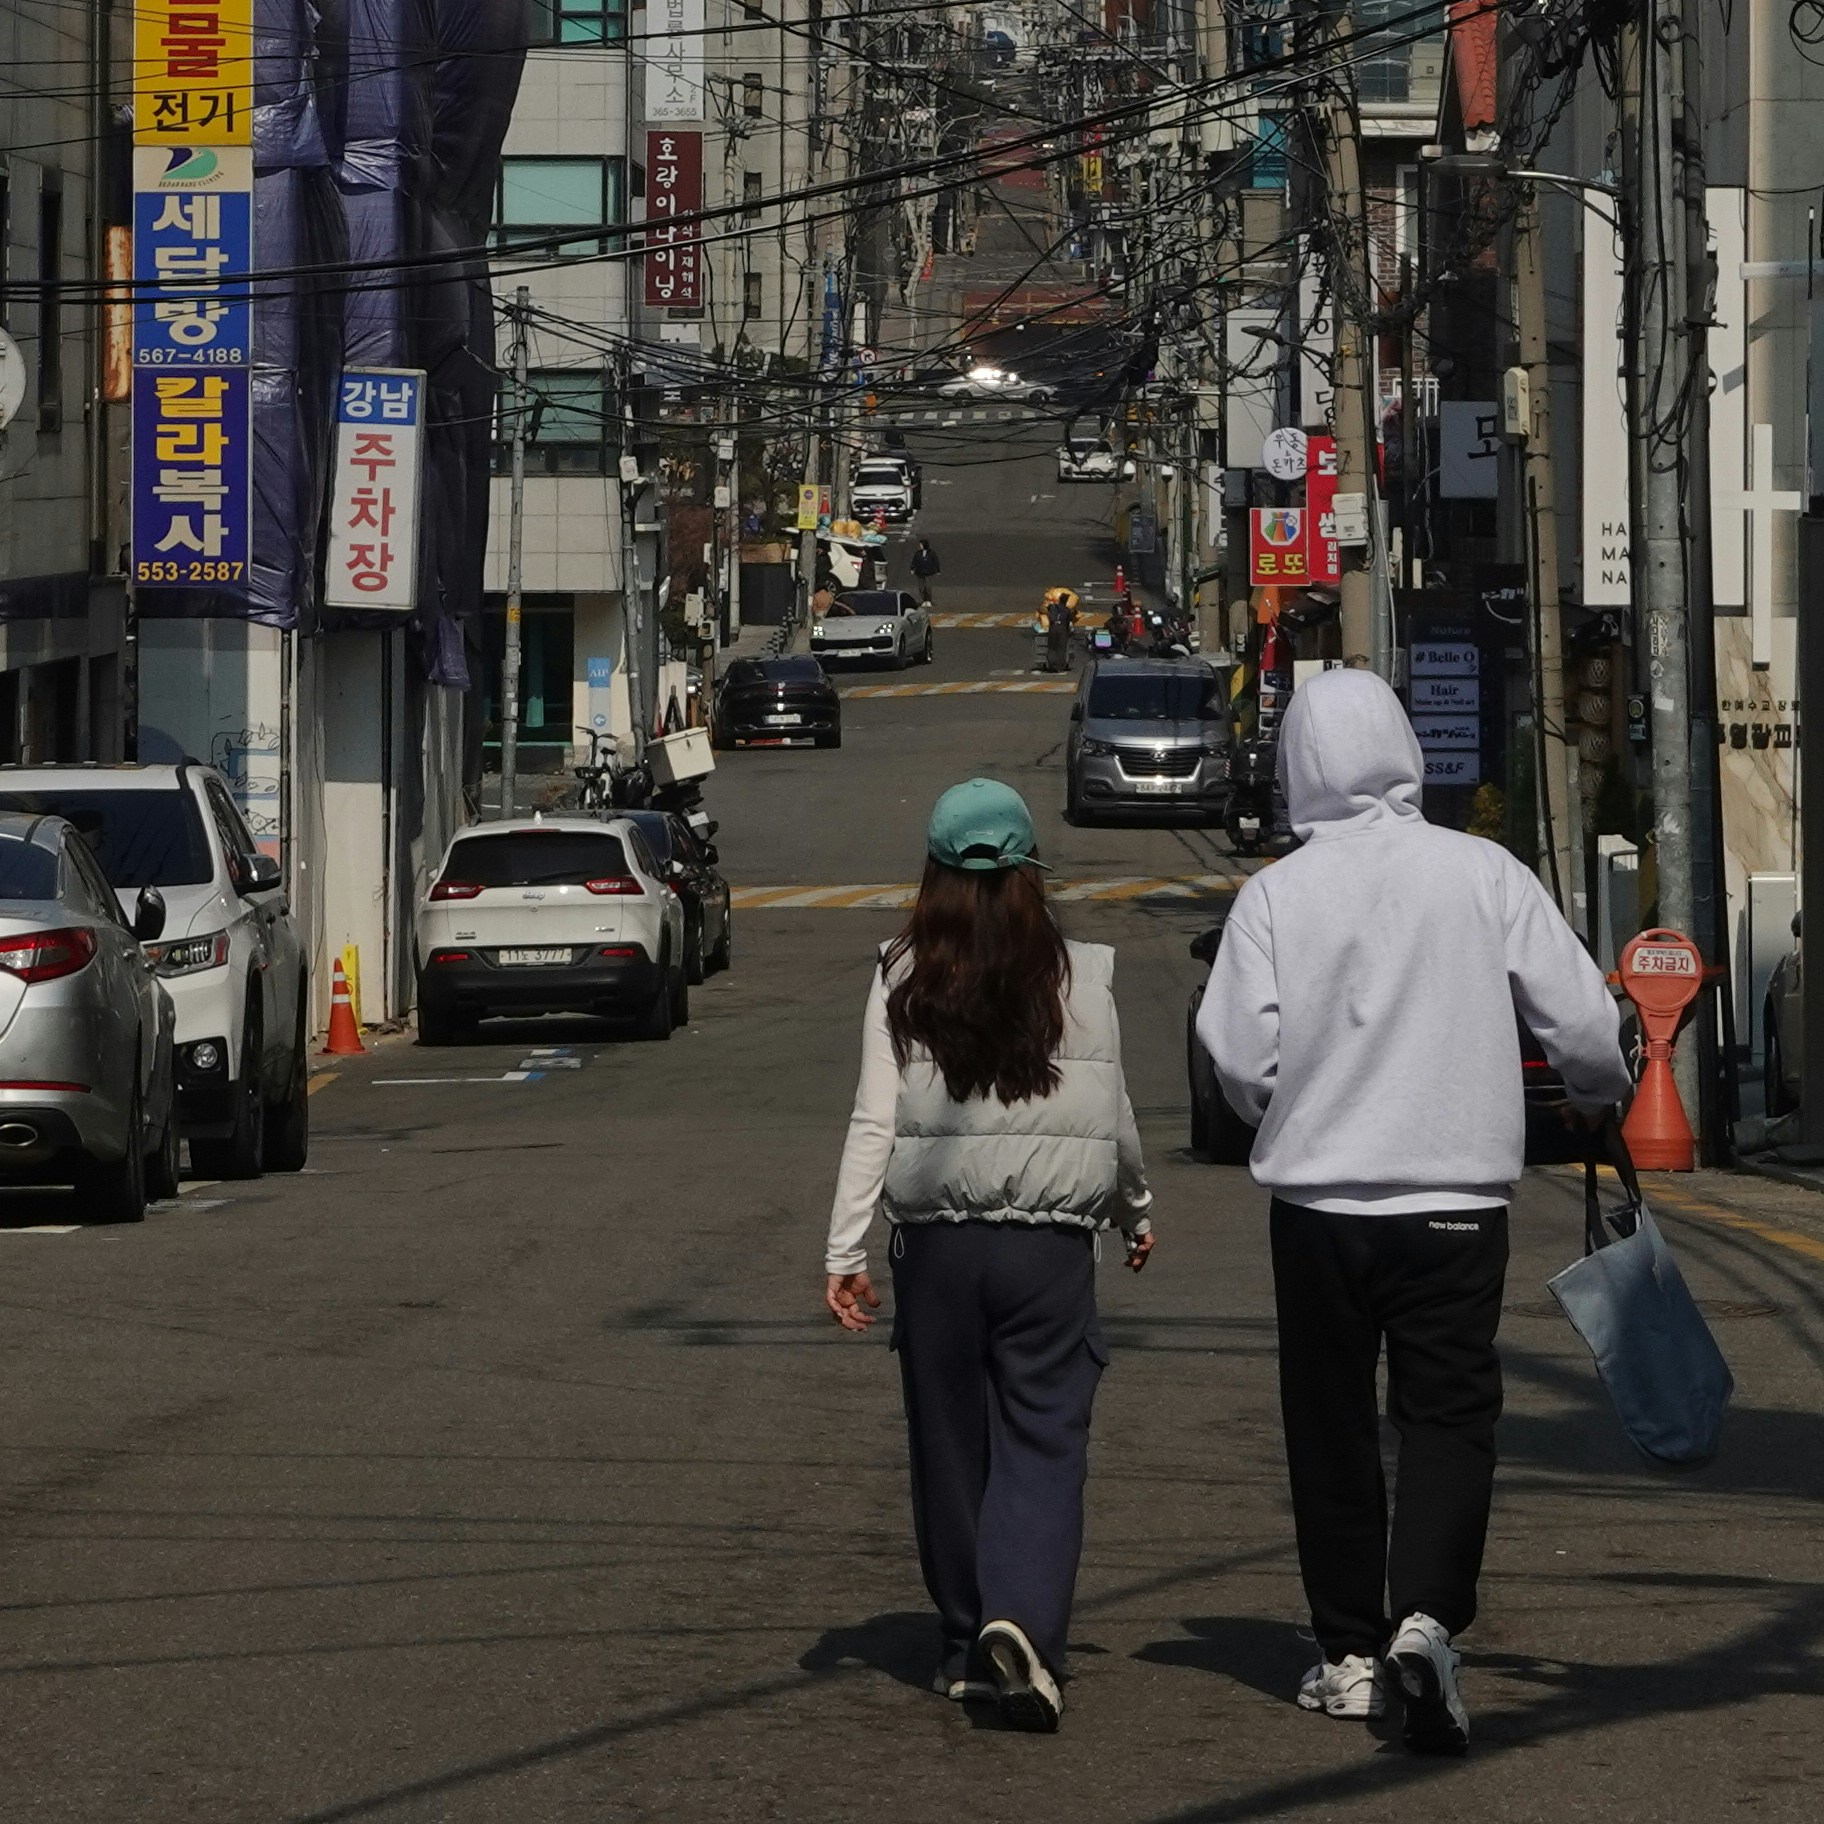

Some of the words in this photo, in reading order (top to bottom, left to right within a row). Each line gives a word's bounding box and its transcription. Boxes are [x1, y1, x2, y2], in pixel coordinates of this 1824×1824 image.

[152, 91, 235, 133] 전기
[138, 348, 242, 364] 567-4188
[342, 380, 414, 419] 강남
[151, 376, 230, 557] 칼라복사
[345, 432, 397, 592] 주차장
[1601, 522, 1628, 536] HA
[136, 561, 244, 581] 553-2587
[1255, 552, 1306, 575] 로또
[1601, 570, 1628, 585] NA
[1430, 684, 1460, 696] Hair
[1638, 955, 1690, 972] 주차금지
[1428, 1220, 1447, 1230] new
[1446, 1221, 1481, 1232] balance
